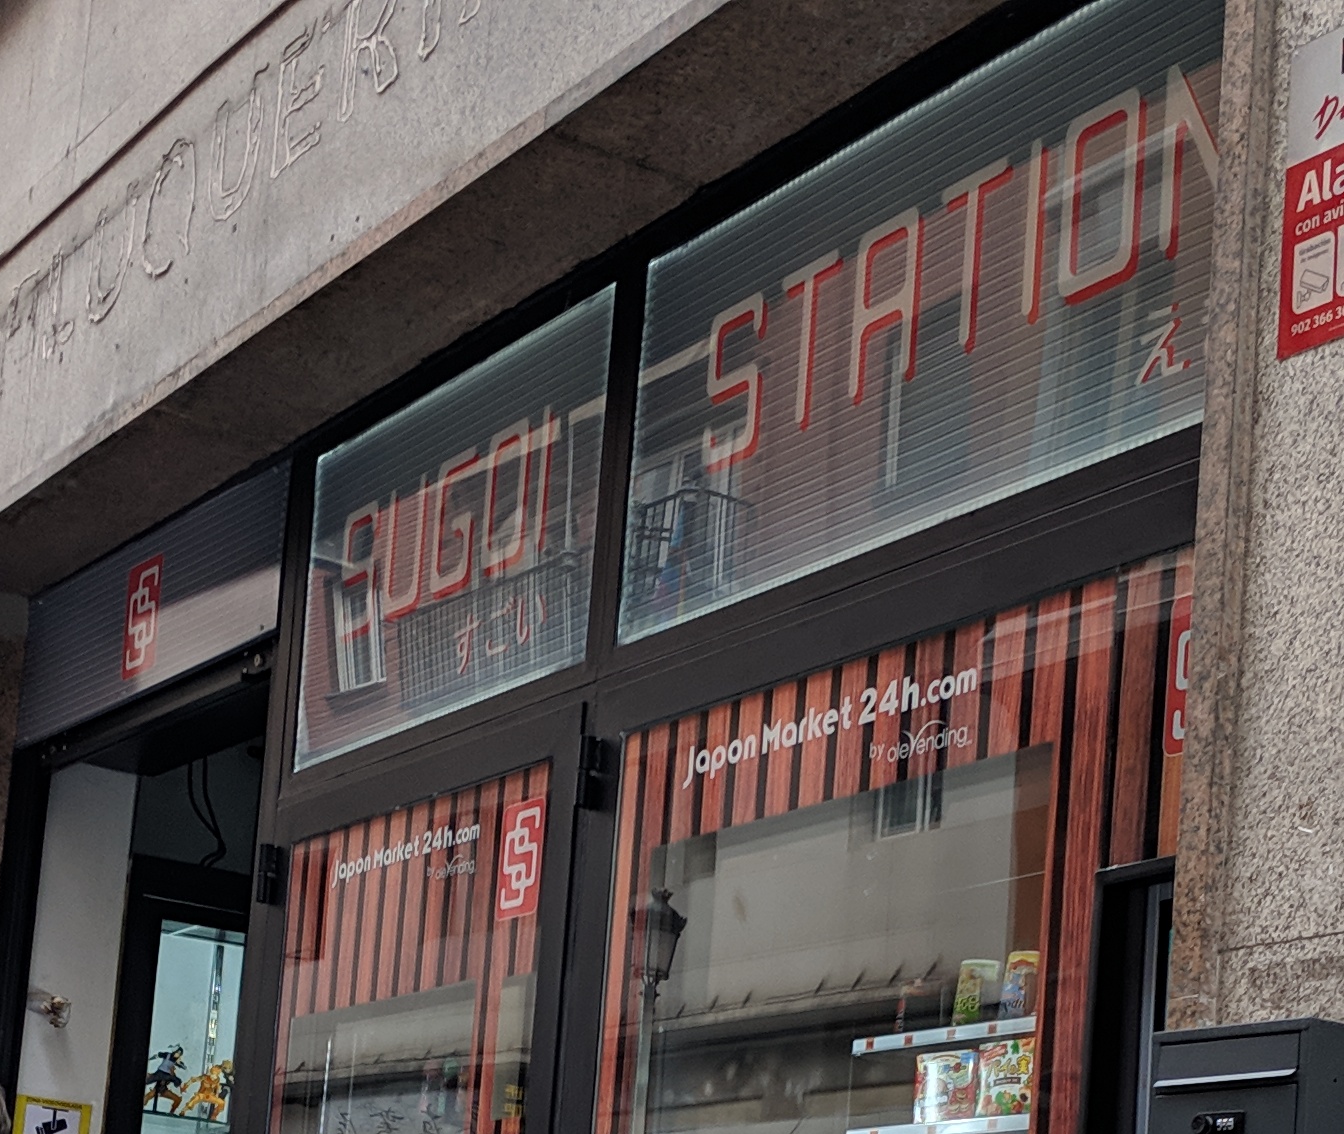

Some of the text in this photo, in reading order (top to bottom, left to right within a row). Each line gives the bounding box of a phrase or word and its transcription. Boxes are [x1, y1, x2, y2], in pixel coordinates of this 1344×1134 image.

[1295, 217, 1320, 236] con
[702, 63, 1218, 473] STATION
[1290, 318, 1311, 337] 902
[1313, 311, 1334, 329] 366
[340, 406, 555, 644] SUGOI
[761, 701, 853, 755] Market
[857, 667, 978, 726] 24h.com
[869, 742, 885, 760] by
[374, 837, 420, 869] Market
[422, 822, 481, 856] 24h.com
